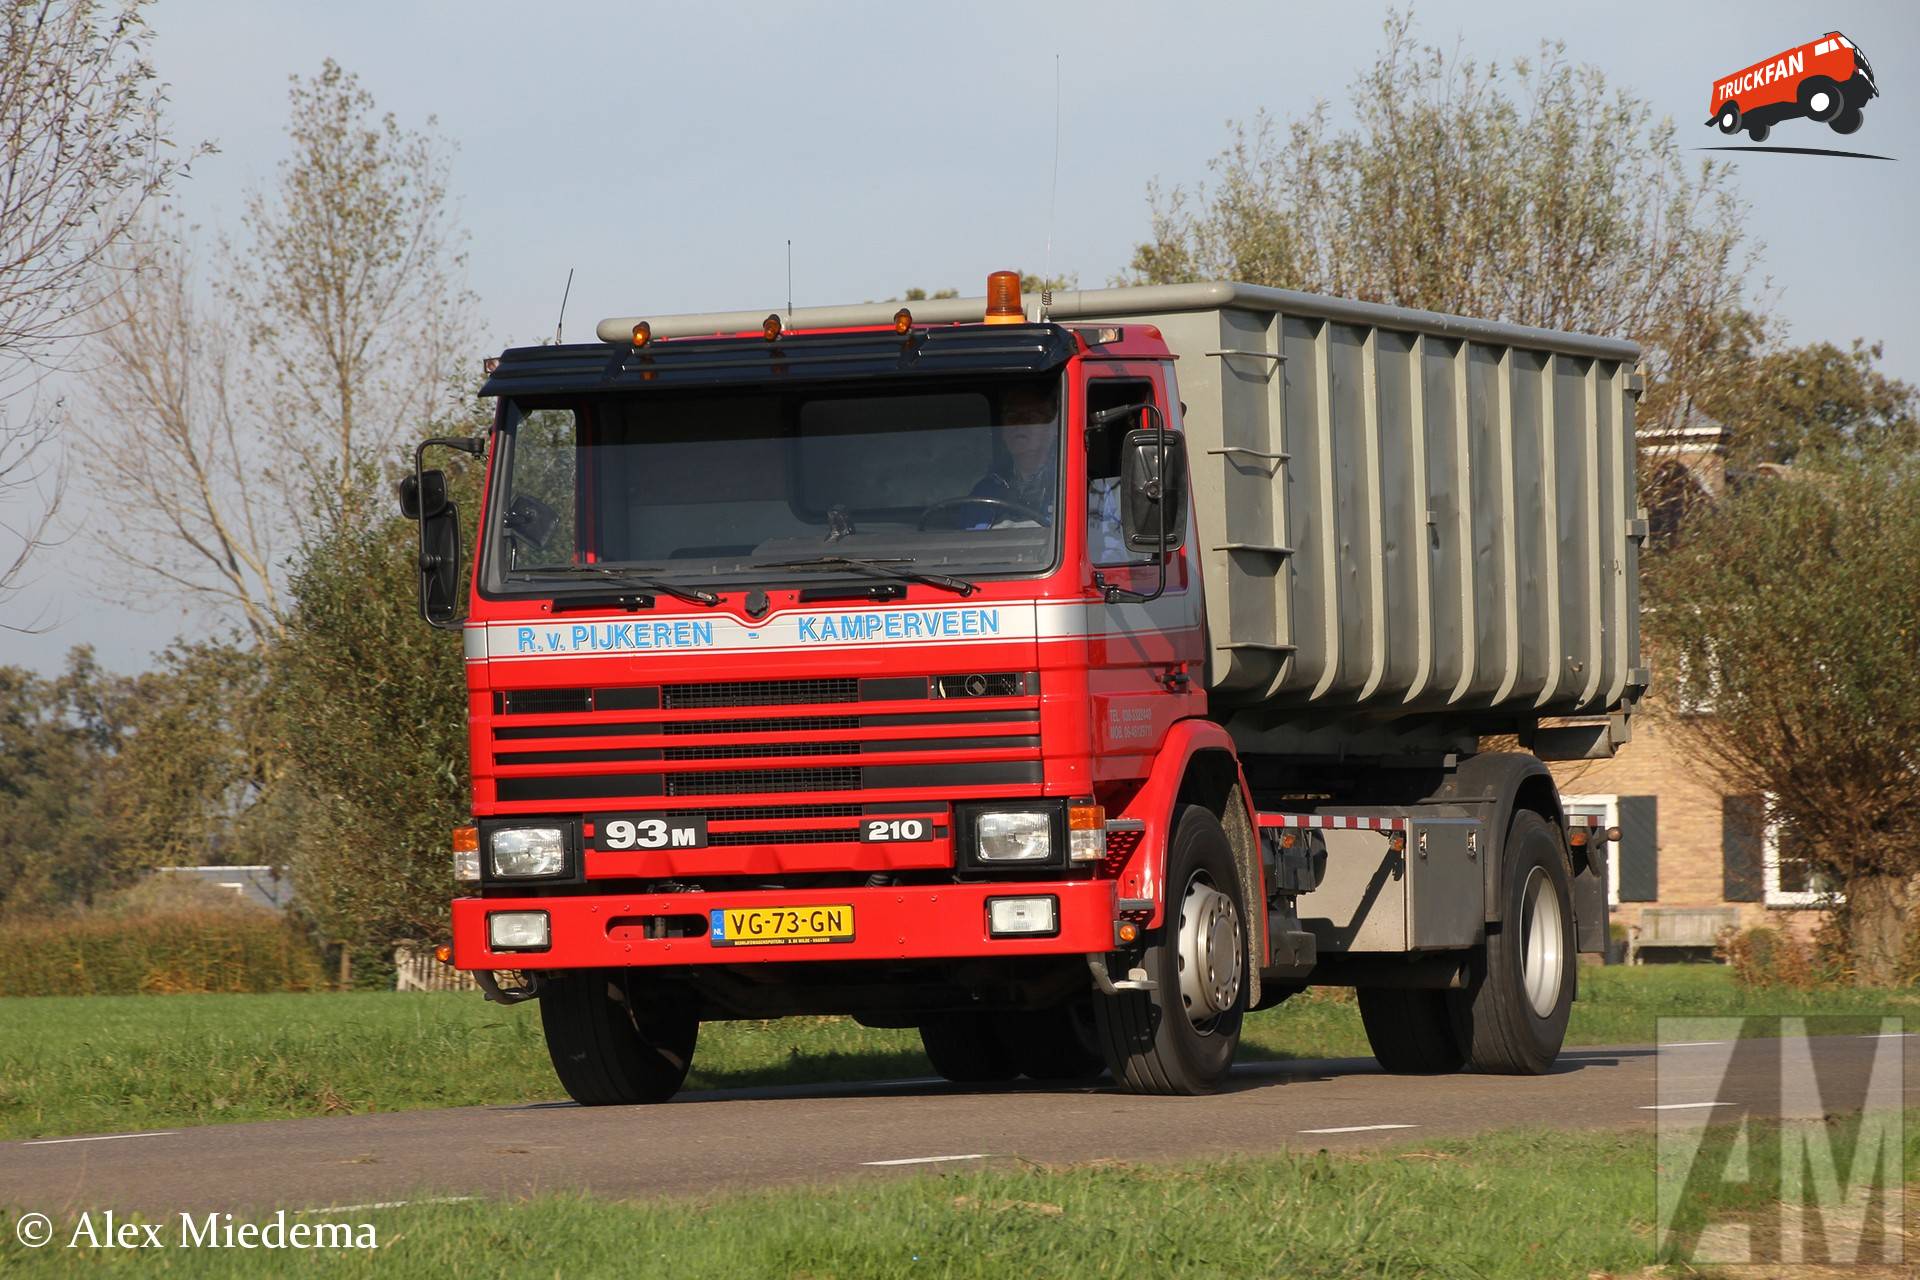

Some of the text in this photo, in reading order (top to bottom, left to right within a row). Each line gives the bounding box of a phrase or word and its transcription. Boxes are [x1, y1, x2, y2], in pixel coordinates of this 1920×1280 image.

[571, 621, 713, 650] PIJKEREN
[798, 609, 1000, 642] KAMPERVEEN
[868, 820, 923, 840] 210
[713, 928, 723, 936] NL
[731, 910, 842, 936] VG-73-GN
